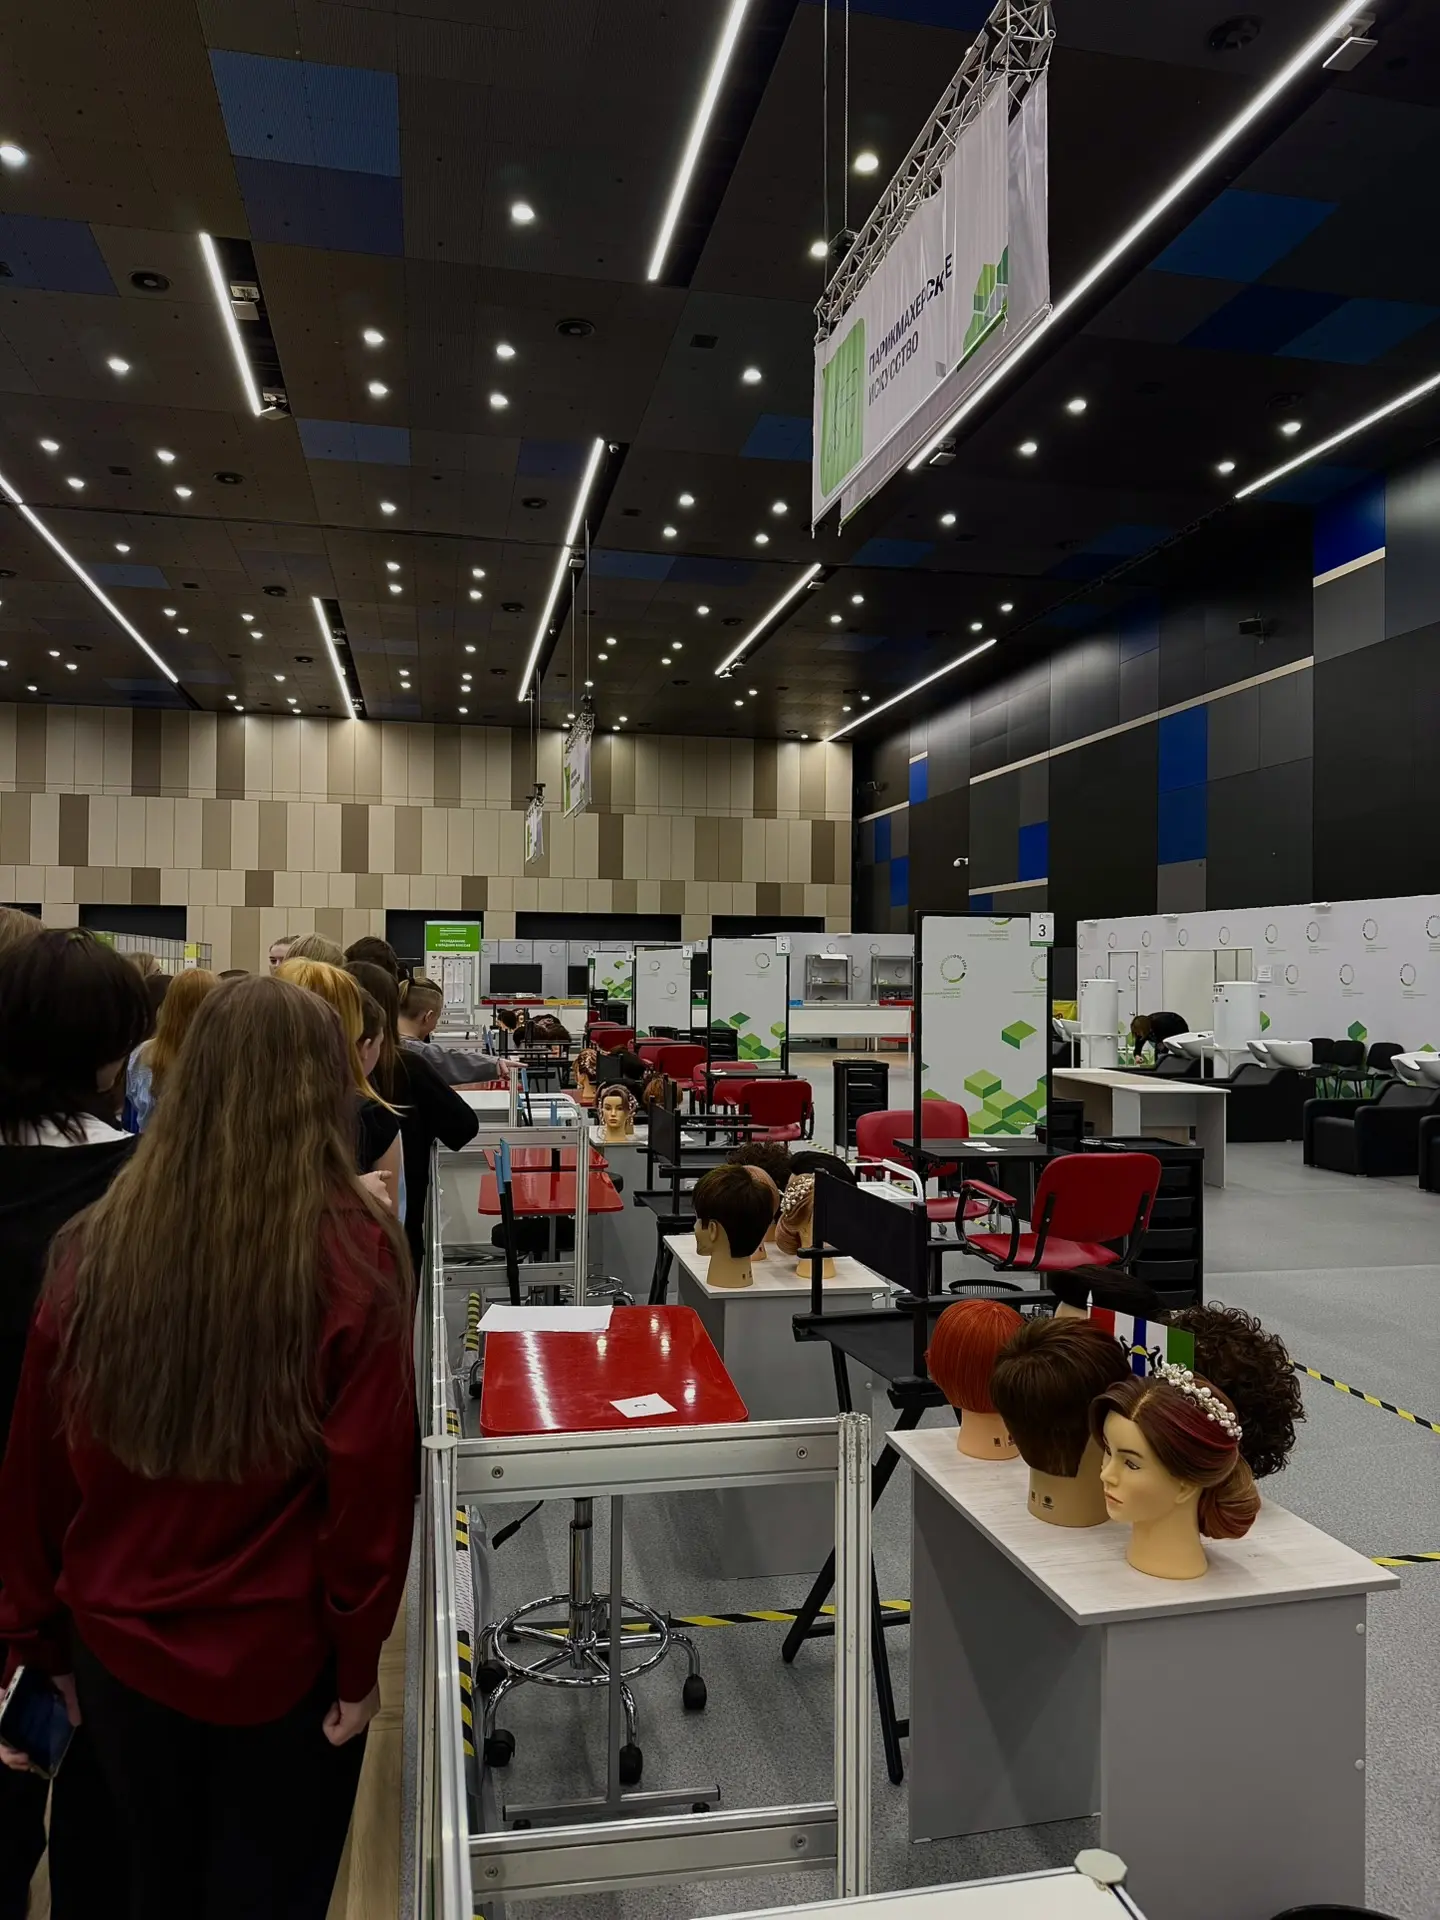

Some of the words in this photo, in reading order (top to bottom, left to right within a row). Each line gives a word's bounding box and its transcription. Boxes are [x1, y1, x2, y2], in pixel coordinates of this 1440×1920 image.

[868, 252, 953, 376] ПАРИКМАХЕРСКЕ
[868, 330, 919, 407] ИСКУССТВО
[781, 942, 787, 951] 5
[1038, 923, 1046, 937] 3
